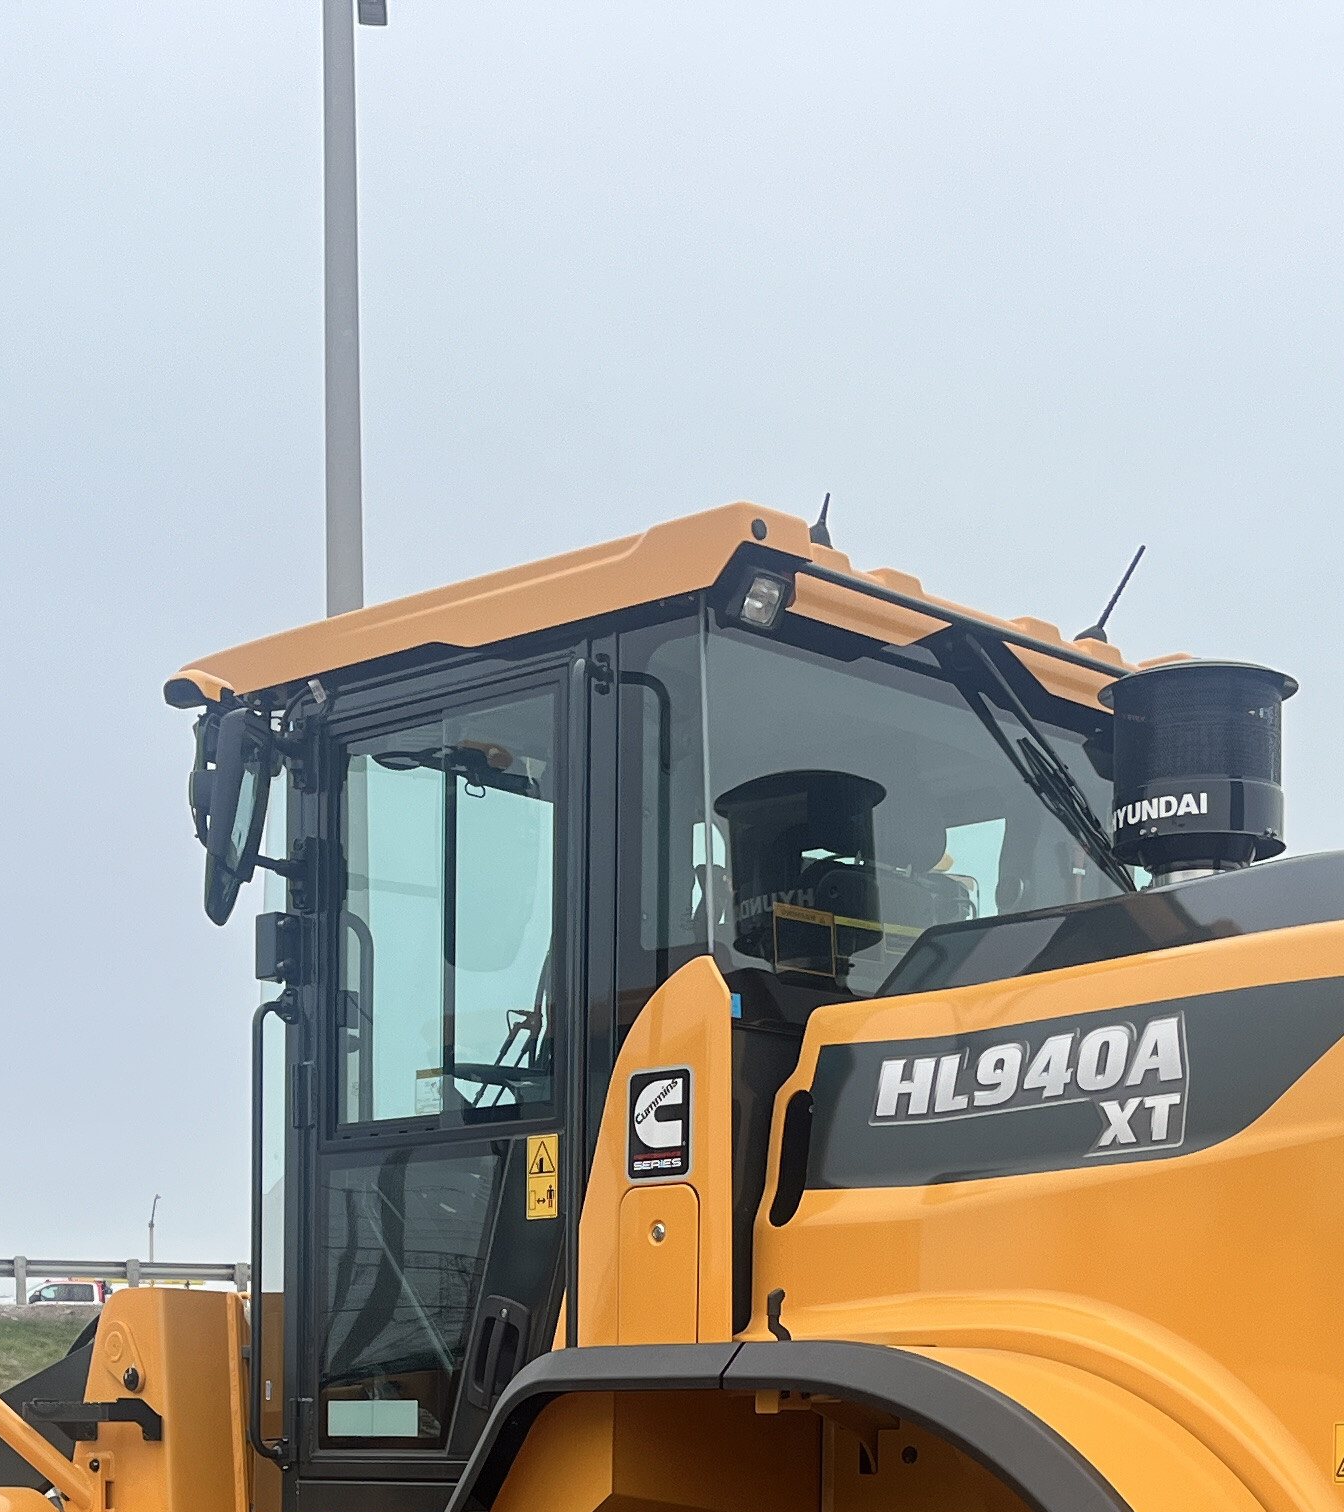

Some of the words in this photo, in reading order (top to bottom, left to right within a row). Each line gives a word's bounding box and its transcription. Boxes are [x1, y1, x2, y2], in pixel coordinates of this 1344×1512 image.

[875, 1016, 1184, 1117] HL940A
[635, 1079, 678, 1125] Cummins
[1098, 1092, 1182, 1147] XT
[633, 1157, 682, 1171] SERIES
